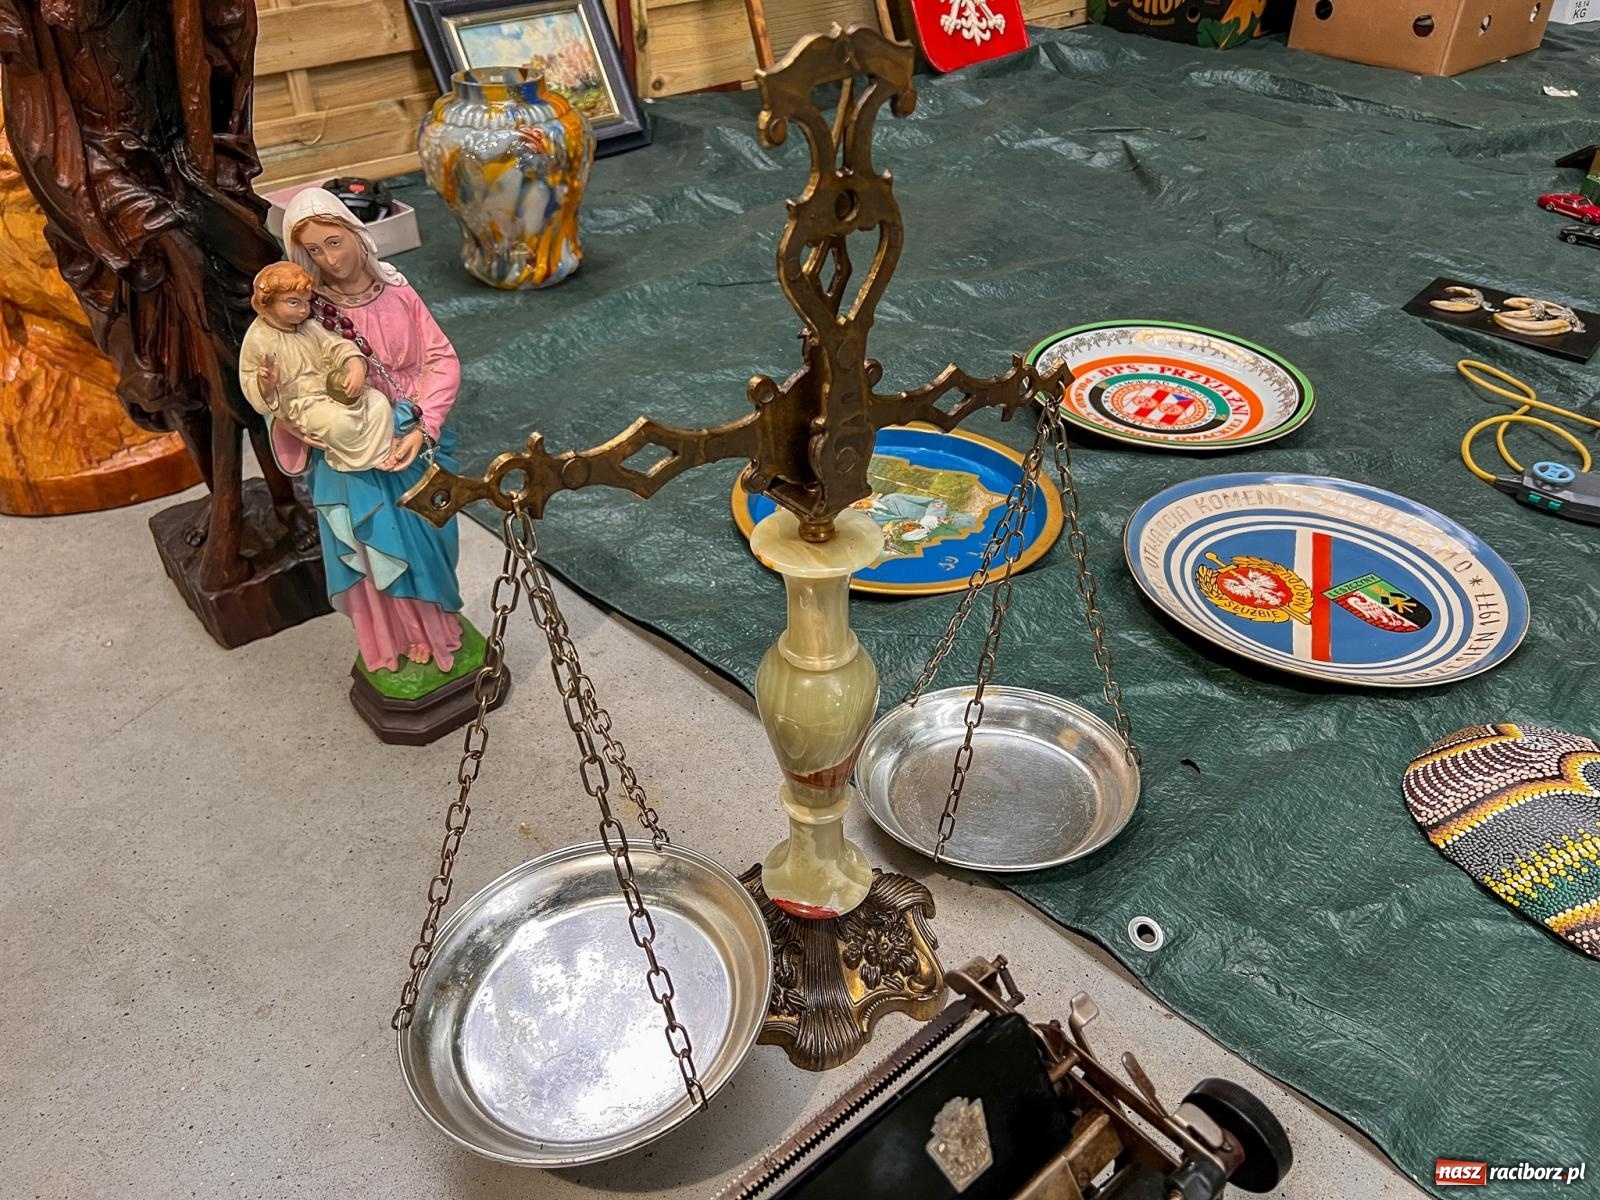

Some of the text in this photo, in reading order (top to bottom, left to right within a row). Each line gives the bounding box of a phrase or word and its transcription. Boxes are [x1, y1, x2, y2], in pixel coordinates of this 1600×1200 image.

[1573, 8, 1587, 19] KG
[1144, 506, 1193, 568] OTWARCIA
[1279, 571, 1307, 609] NARODU
[1327, 573, 1377, 598] LESZCZYNY
[1473, 592, 1501, 626] 1977
